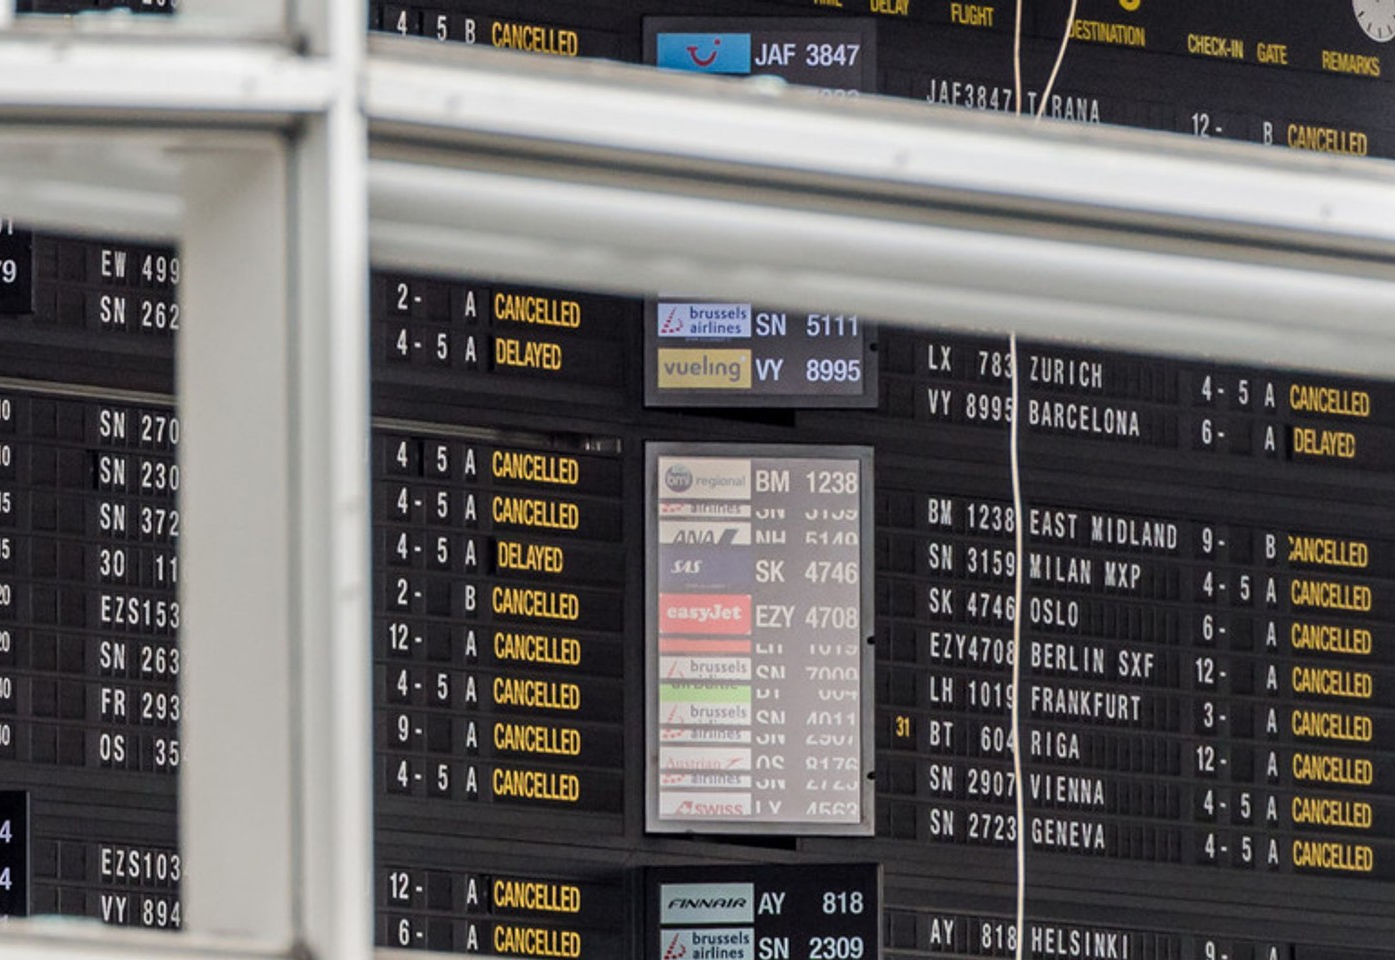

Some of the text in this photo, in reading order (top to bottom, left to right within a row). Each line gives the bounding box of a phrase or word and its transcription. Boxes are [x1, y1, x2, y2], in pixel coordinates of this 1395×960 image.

[951, 3, 994, 26] FLIGHT
[492, 22, 577, 57] CANCELLED
[1188, 34, 1243, 58] CHECK-IN
[755, 44, 859, 66] JAF 3847
[1257, 43, 1287, 64] GATE
[1322, 51, 1380, 76] REMARKS
[496, 338, 561, 370] DELAYED
[664, 358, 742, 381] vueling
[756, 359, 860, 381] VY 8995
[929, 345, 1369, 416] LX ZURICH CANCELLED
[929, 389, 1355, 458] VY BARCELONA DELAYED
[1030, 509, 1176, 549] EAST MIDLAND
[756, 560, 858, 584] SK 4746
[1030, 553, 1371, 611] MILAN MXP CANCELLED
[667, 604, 742, 623] easyJet
[756, 605, 859, 629] EZY 4708
[1031, 598, 1371, 654] OSLO CANCELLED
[1032, 686, 1372, 741] FRANKFURT CANCELLED
[668, 898, 746, 909] FINNAIR
[758, 892, 863, 914] AY 818
[693, 931, 749, 945] brussels
[759, 937, 863, 960] SN 2309
[1032, 927, 1127, 959] HELSINKI
[693, 946, 744, 959] airlines
